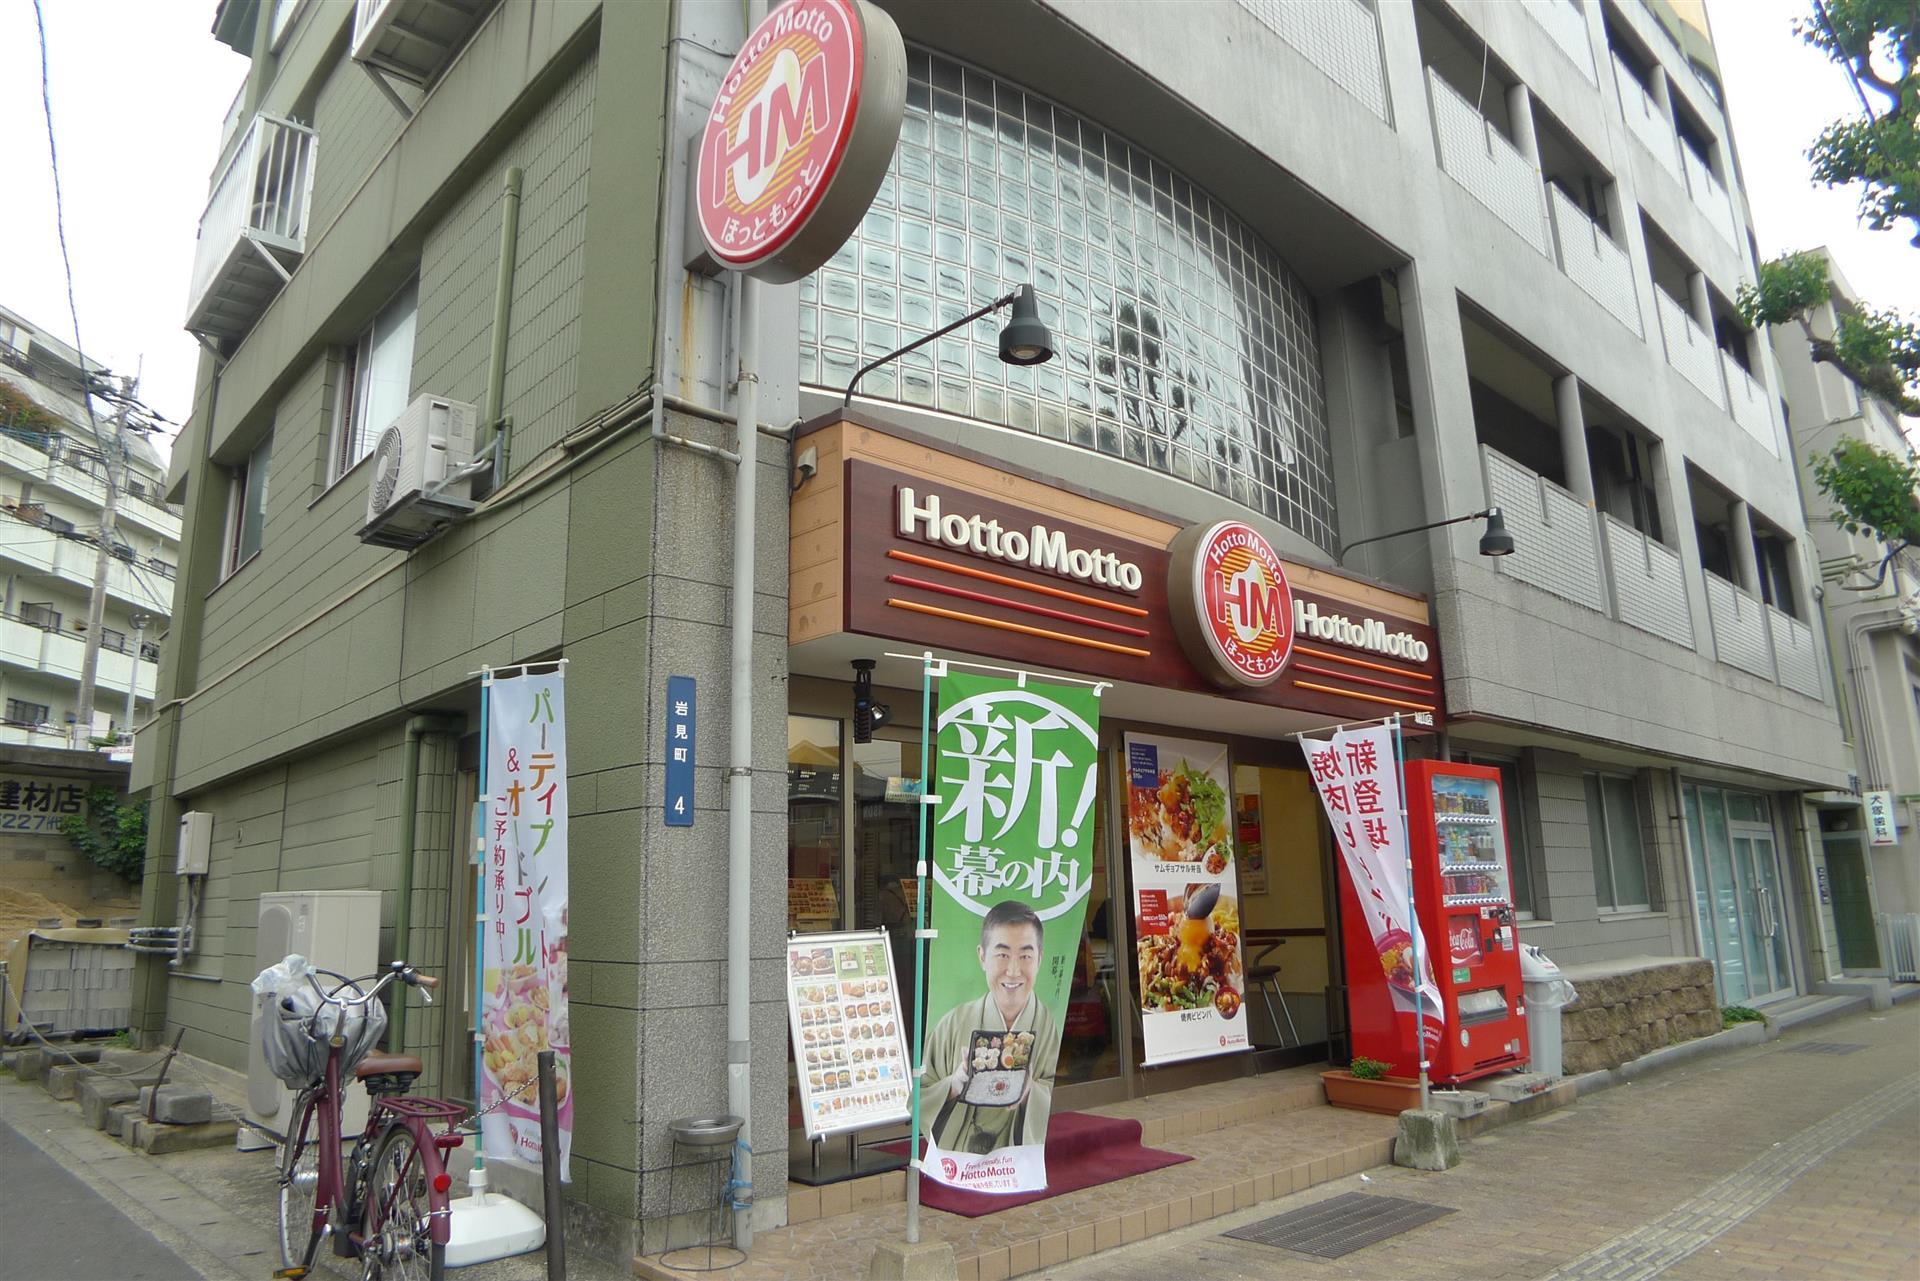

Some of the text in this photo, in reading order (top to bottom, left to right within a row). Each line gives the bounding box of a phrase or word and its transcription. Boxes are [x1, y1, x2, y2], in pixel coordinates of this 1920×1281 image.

[721, 159, 820, 245] ほっともっと
[1225, 637, 1283, 672] ほっともっと
[674, 701, 689, 815] 岩見町 4
[946, 844, 1081, 899] 幕の内
